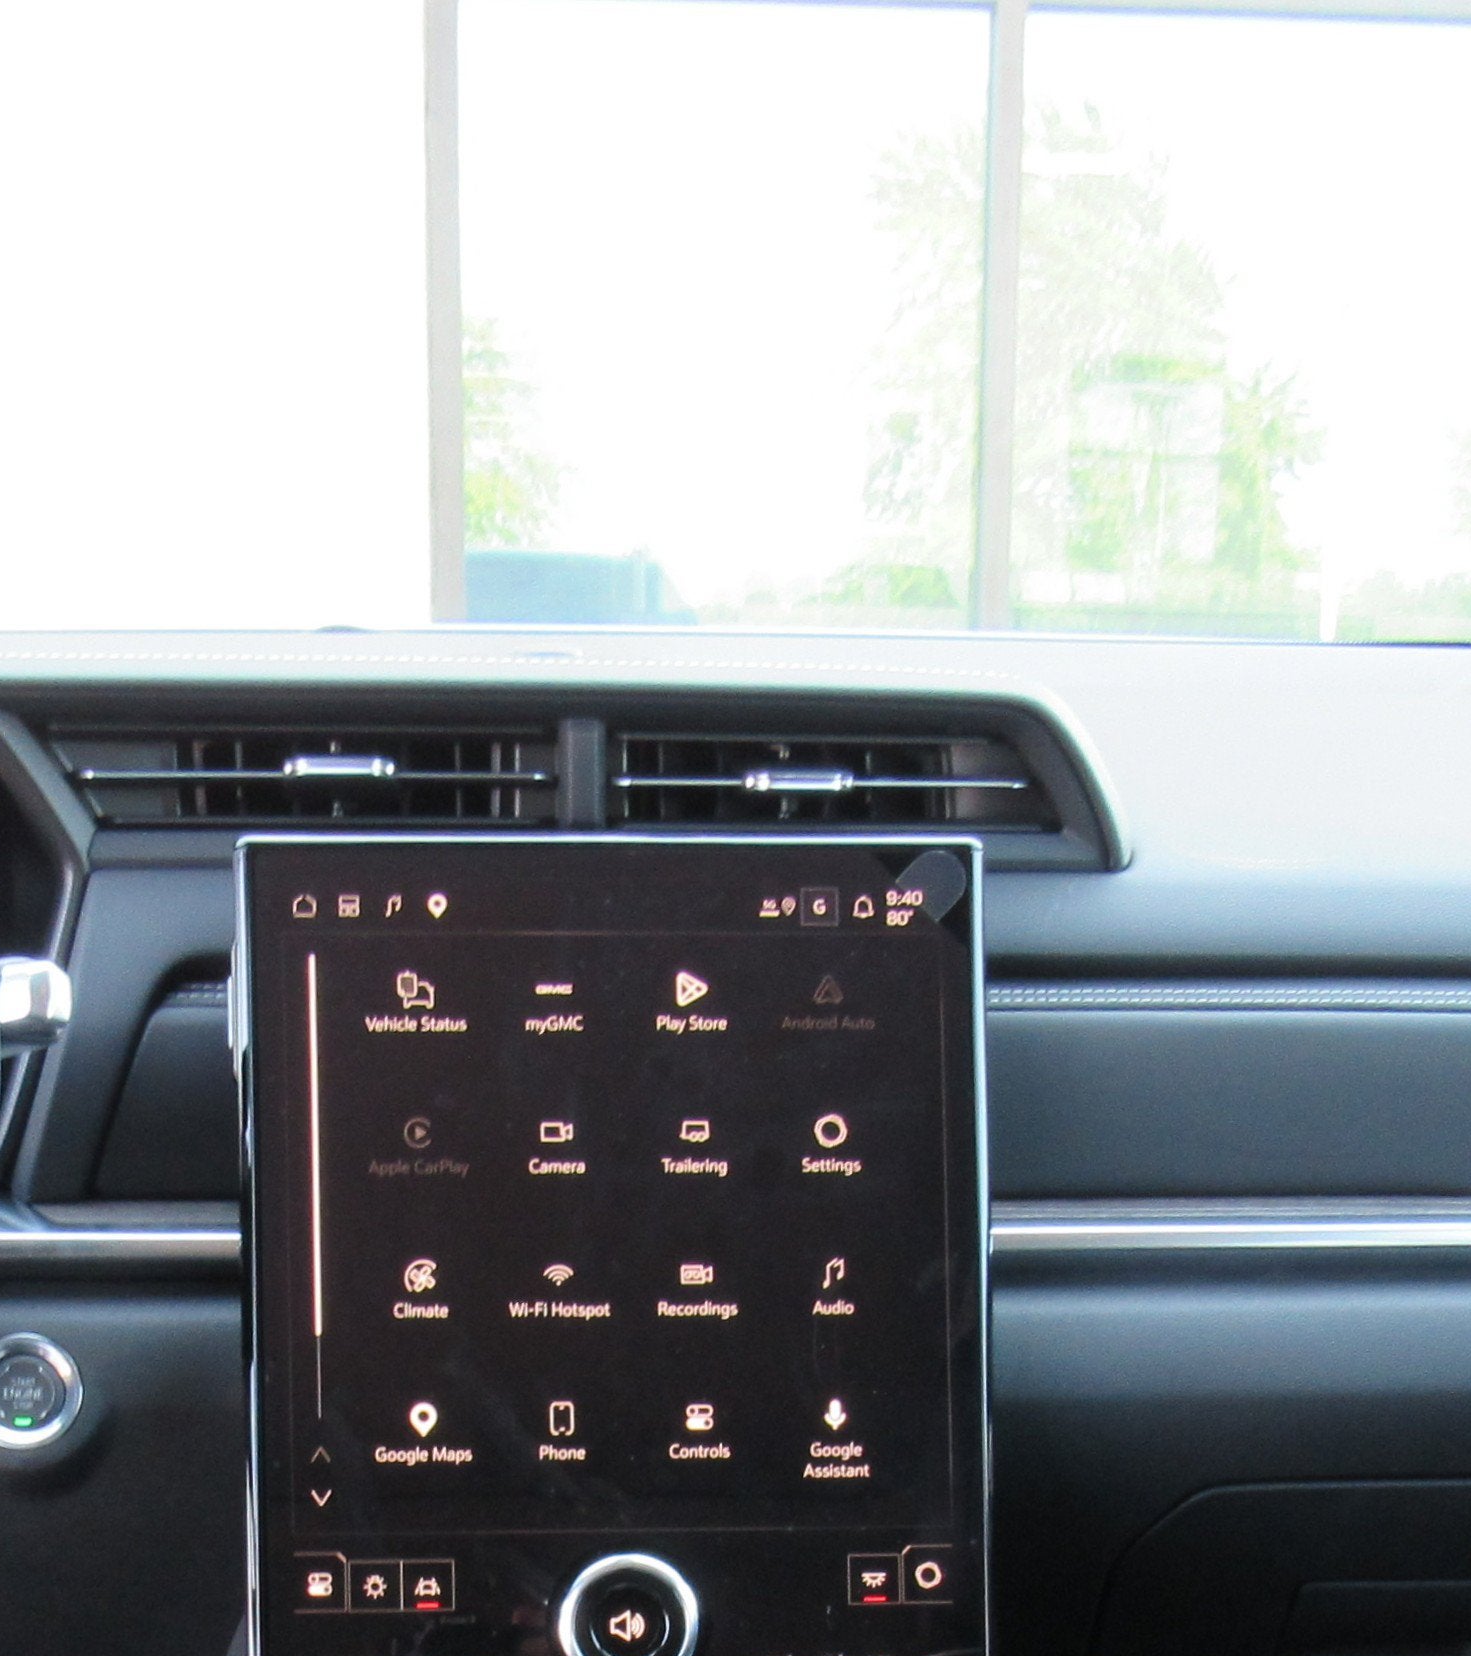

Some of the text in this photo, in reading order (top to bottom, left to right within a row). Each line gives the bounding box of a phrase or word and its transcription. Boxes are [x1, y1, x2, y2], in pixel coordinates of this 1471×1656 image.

[812, 898, 827, 916] G
[886, 890, 923, 907] 9:40
[365, 1016, 467, 1032] Vehicle Status
[526, 1015, 583, 1034] myGMC
[657, 1015, 727, 1034] Play Store
[782, 1016, 875, 1031] Android Auto
[369, 1158, 469, 1179] Apple CarPlay
[529, 1158, 585, 1174] Camera
[662, 1158, 727, 1176] Trailering
[802, 1157, 861, 1176] Settings
[394, 1303, 448, 1318] Climate
[509, 1302, 610, 1320] Wi-Fi Hotspot
[658, 1301, 738, 1319] Recordings
[813, 1300, 854, 1315] Audio
[375, 1447, 472, 1466] Google Maps
[539, 1445, 586, 1460] Phone
[669, 1443, 730, 1459] Controls
[810, 1442, 862, 1460] Google
[803, 1459, 869, 1478] Assistant
